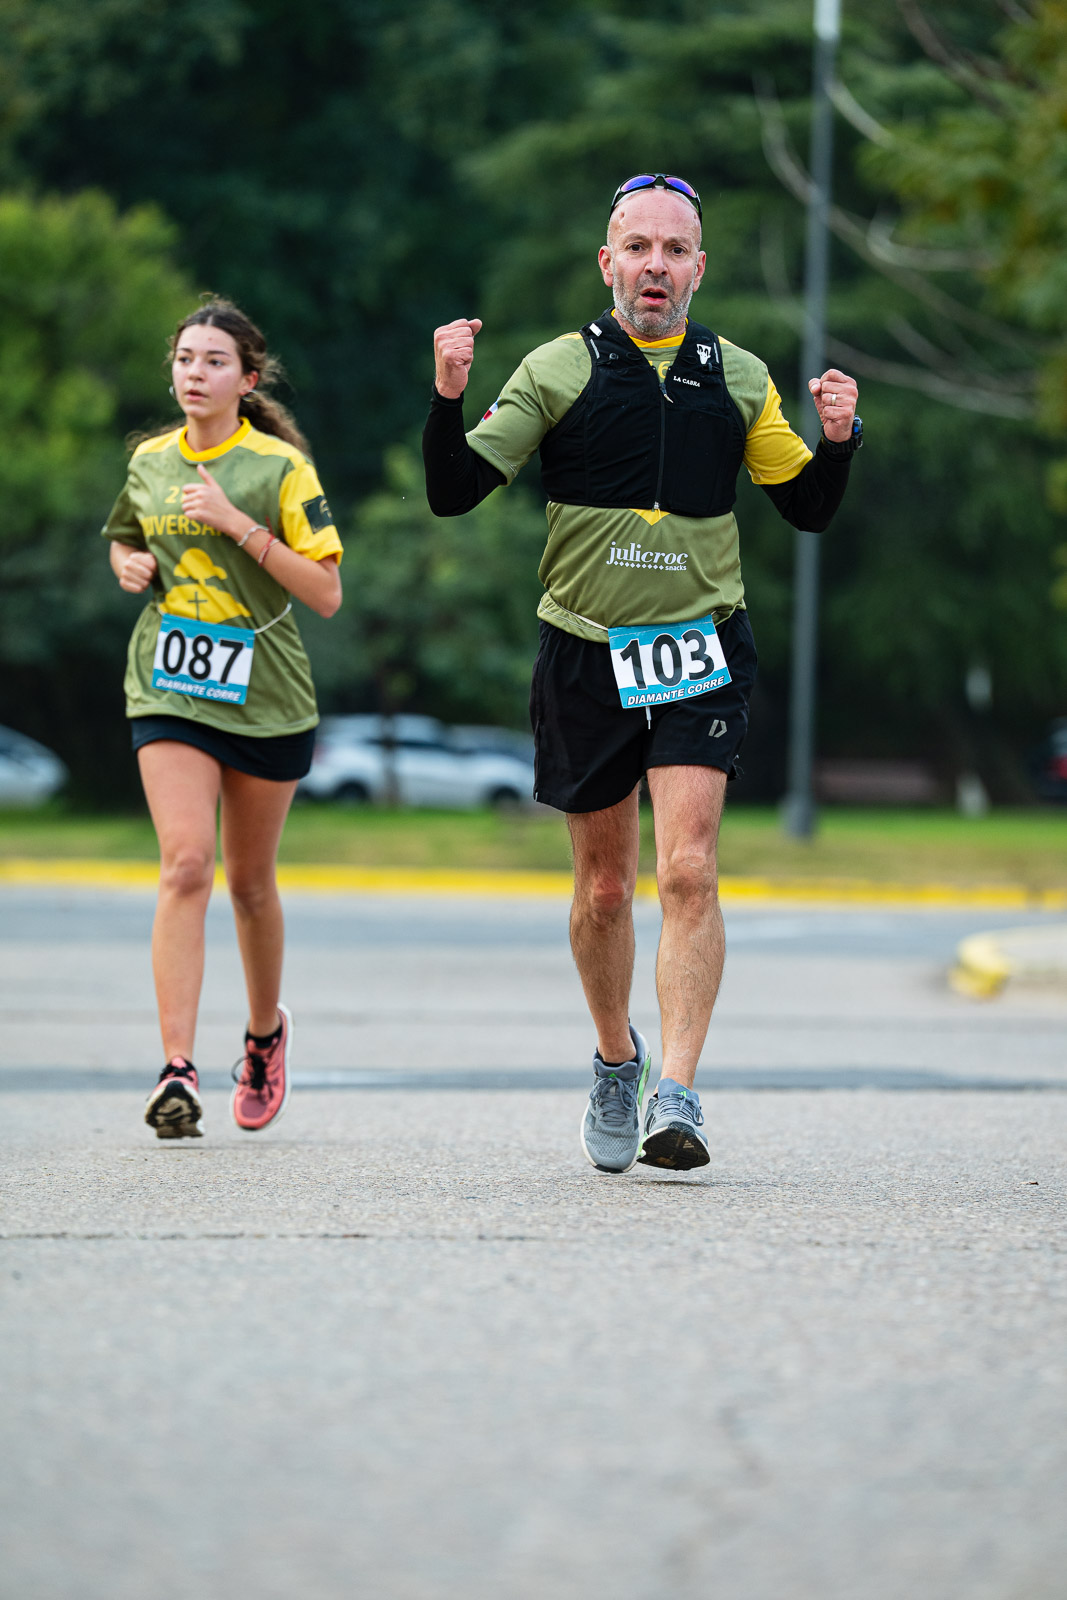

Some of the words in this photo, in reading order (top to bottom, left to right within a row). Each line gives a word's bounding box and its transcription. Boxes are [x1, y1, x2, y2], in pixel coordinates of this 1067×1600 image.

[673, 375, 682, 383] LA
[606, 541, 689, 565] julicroc
[162, 628, 245, 685] 087
[619, 628, 715, 690] 103
[156, 677, 206, 696] DIAMANTE
[206, 687, 241, 702] CORRE
[627, 688, 685, 706] DIAMANTE
[687, 676, 725, 695] CORRE
